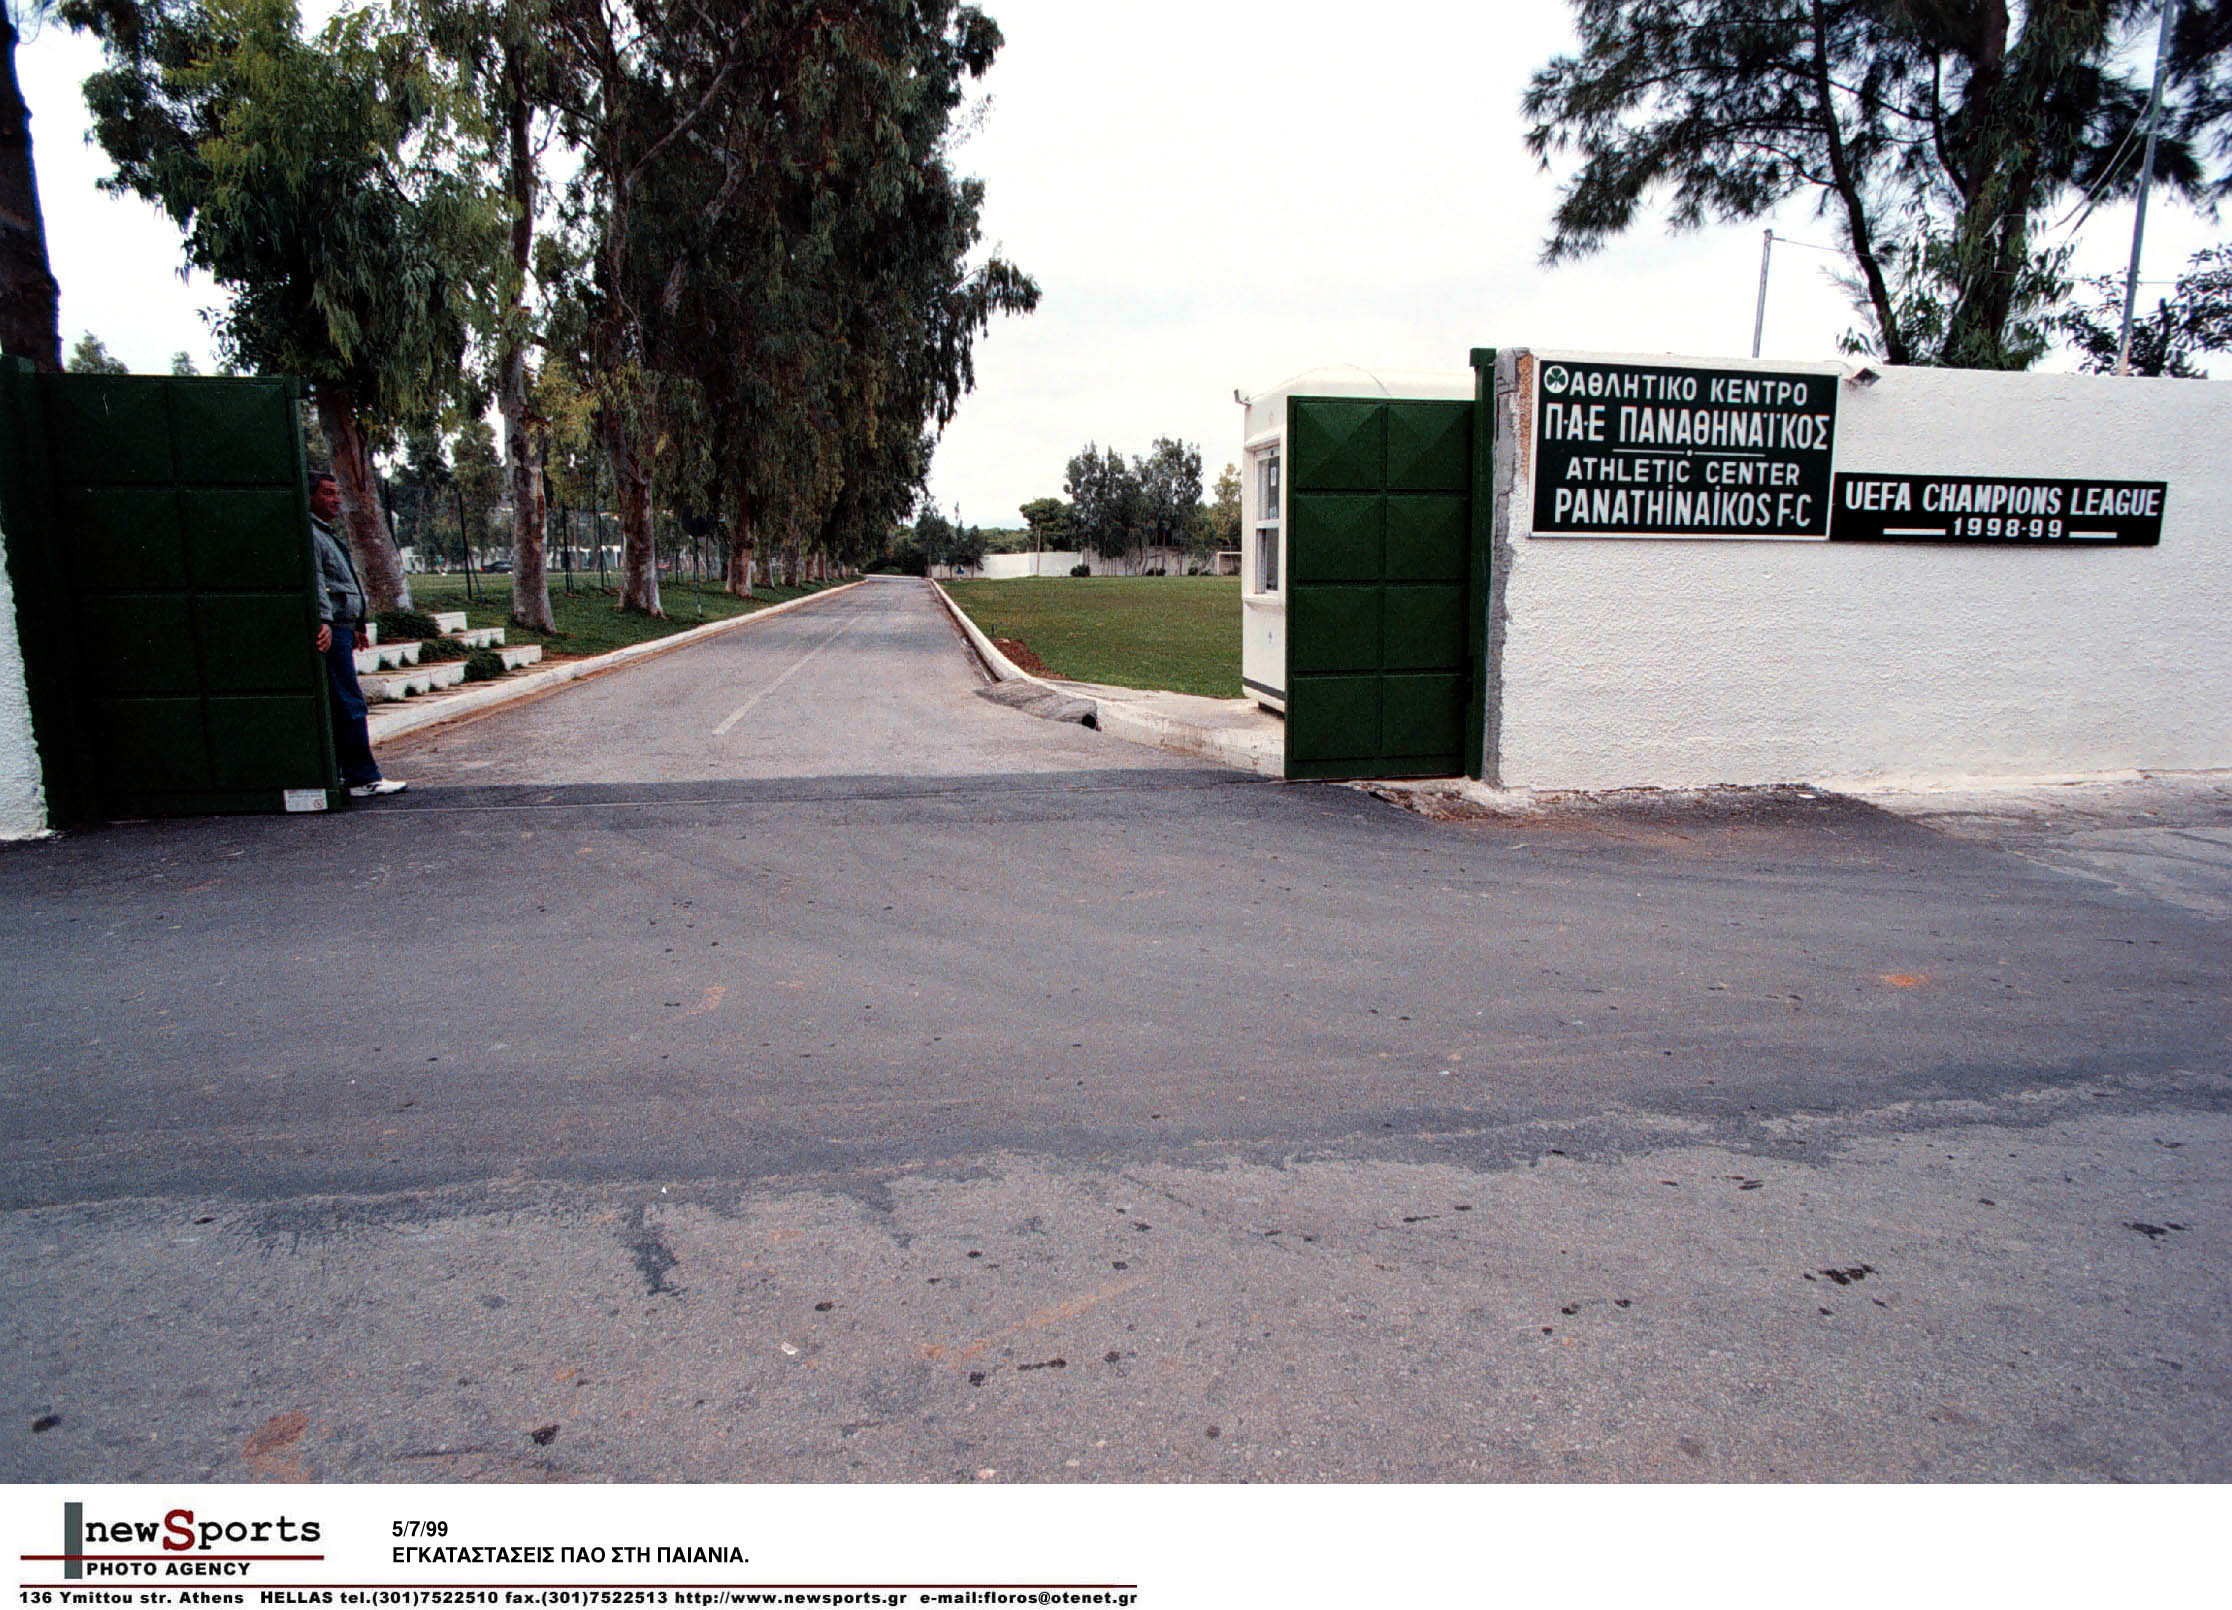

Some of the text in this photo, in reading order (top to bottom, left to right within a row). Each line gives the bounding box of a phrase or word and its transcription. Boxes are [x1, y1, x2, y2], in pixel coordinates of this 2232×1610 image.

[1569, 371, 1808, 407] ΑΘΛΗΤΙΚΟ ΚΕΝΤΡΟ
[1565, 457, 1801, 487] ATHLETIC CENTER
[1845, 481, 2161, 517] UEFA CHAMPIONS LEAGUE
